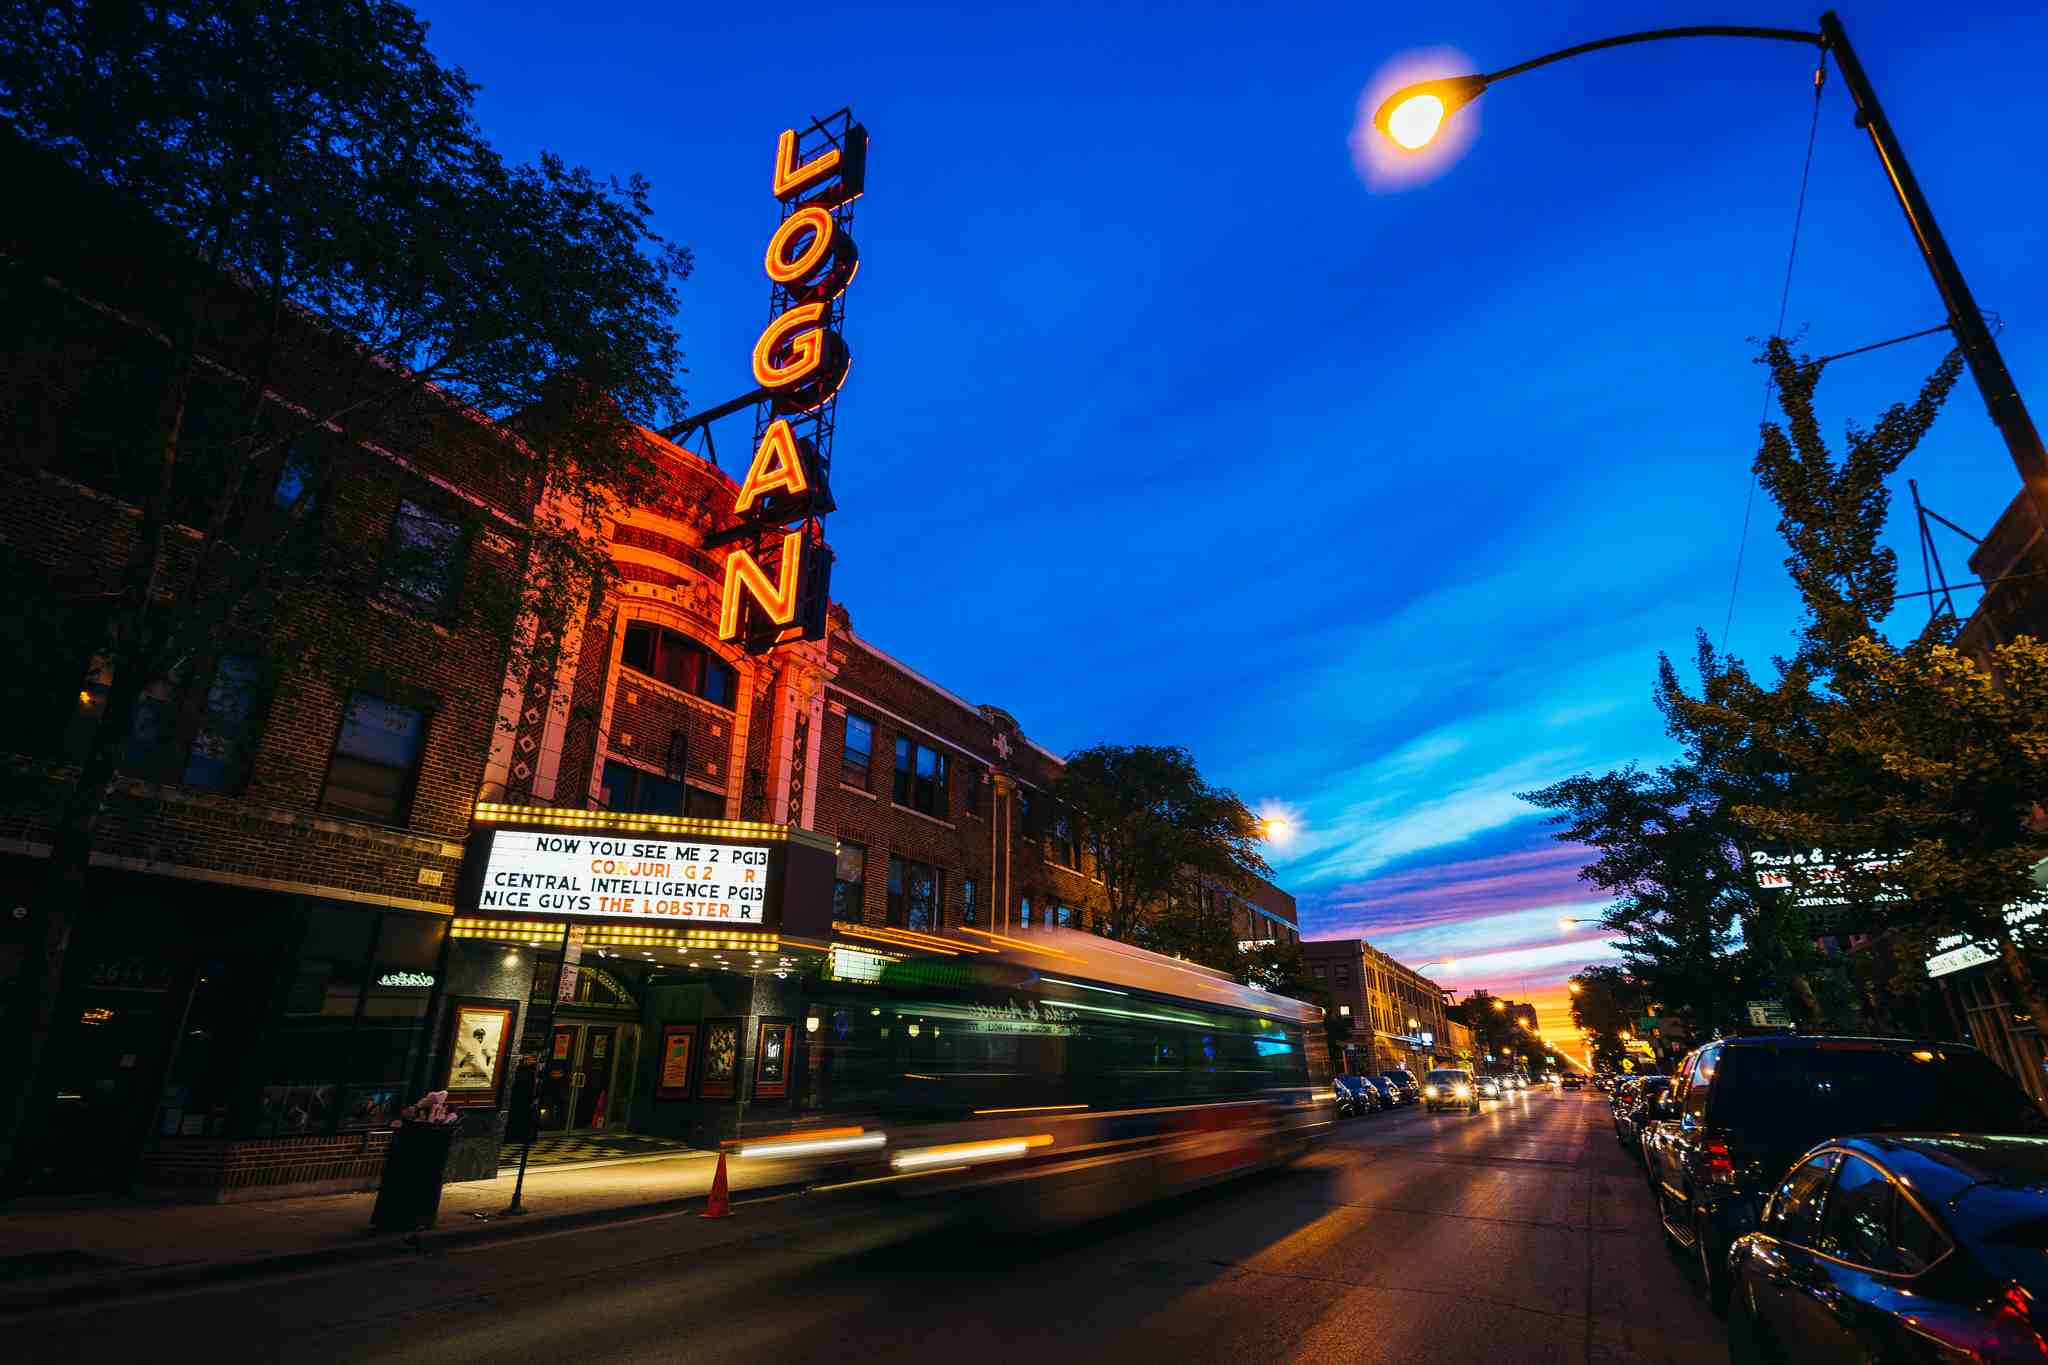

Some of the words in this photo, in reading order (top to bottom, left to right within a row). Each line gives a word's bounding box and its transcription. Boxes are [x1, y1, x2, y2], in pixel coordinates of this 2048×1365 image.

[719, 128, 842, 641] LOGAN
[536, 837, 581, 854] NOW
[589, 841, 626, 856] YOU
[632, 844, 668, 859] SEE
[675, 847, 700, 861] ME
[710, 849, 719, 862] 2
[732, 850, 767, 865] PG13
[495, 872, 581, 891] CENTRAL
[591, 878, 721, 898] INTELLIGENCE
[728, 886, 763, 901] PG13
[703, 866, 713, 880] 2
[745, 869, 756, 882] R
[483, 890, 531, 907] NICE
[538, 894, 591, 910] GUYS
[598, 896, 635, 913] THE
[643, 900, 730, 917] LOBSTER
[741, 904, 751, 918] R
